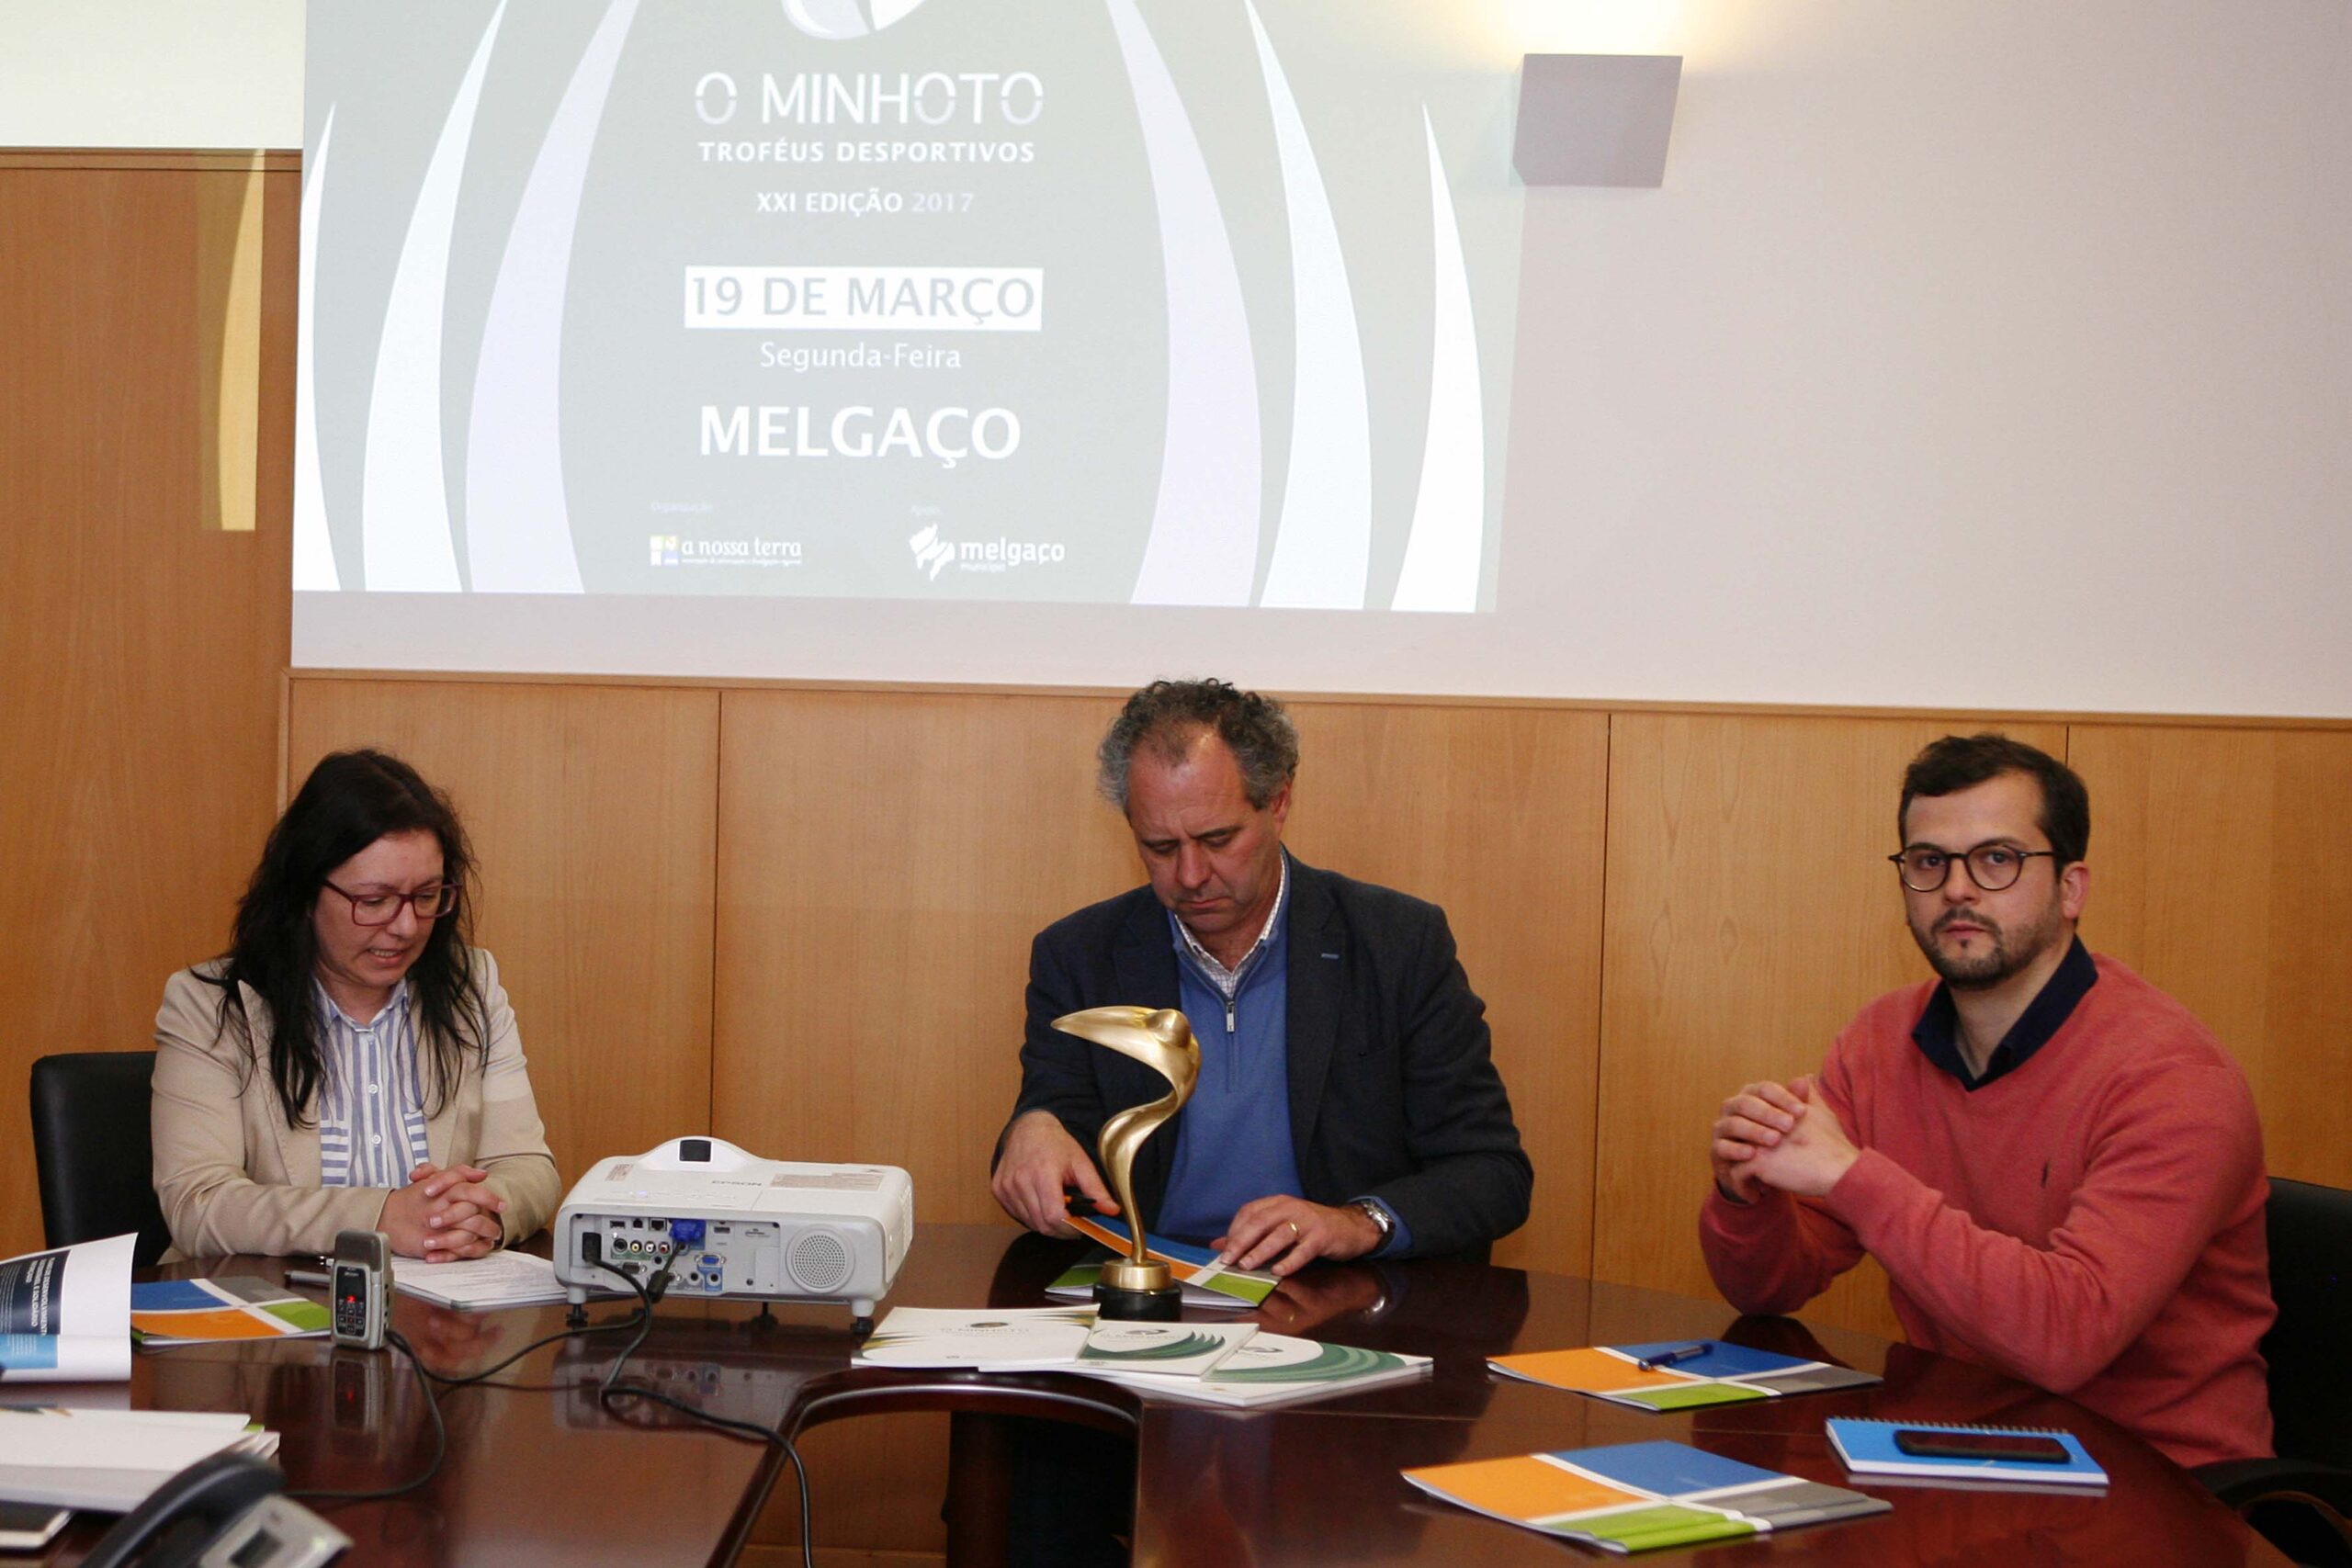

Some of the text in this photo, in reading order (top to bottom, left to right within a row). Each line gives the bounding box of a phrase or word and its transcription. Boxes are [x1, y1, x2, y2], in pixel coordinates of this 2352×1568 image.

[695, 72, 1044, 125] O MINHOTO
[698, 138, 1035, 164] TROFÉUS DESPORTIVOS
[756, 187, 975, 217] XXI EDIÇÃO 2017
[692, 276, 1035, 325] 19 DE MARÇO
[760, 342, 962, 372] Segunda-Feira
[700, 405, 1021, 469] MELGAÇO
[681, 536, 802, 557] a nossa terra
[959, 536, 1066, 567] melgaço
